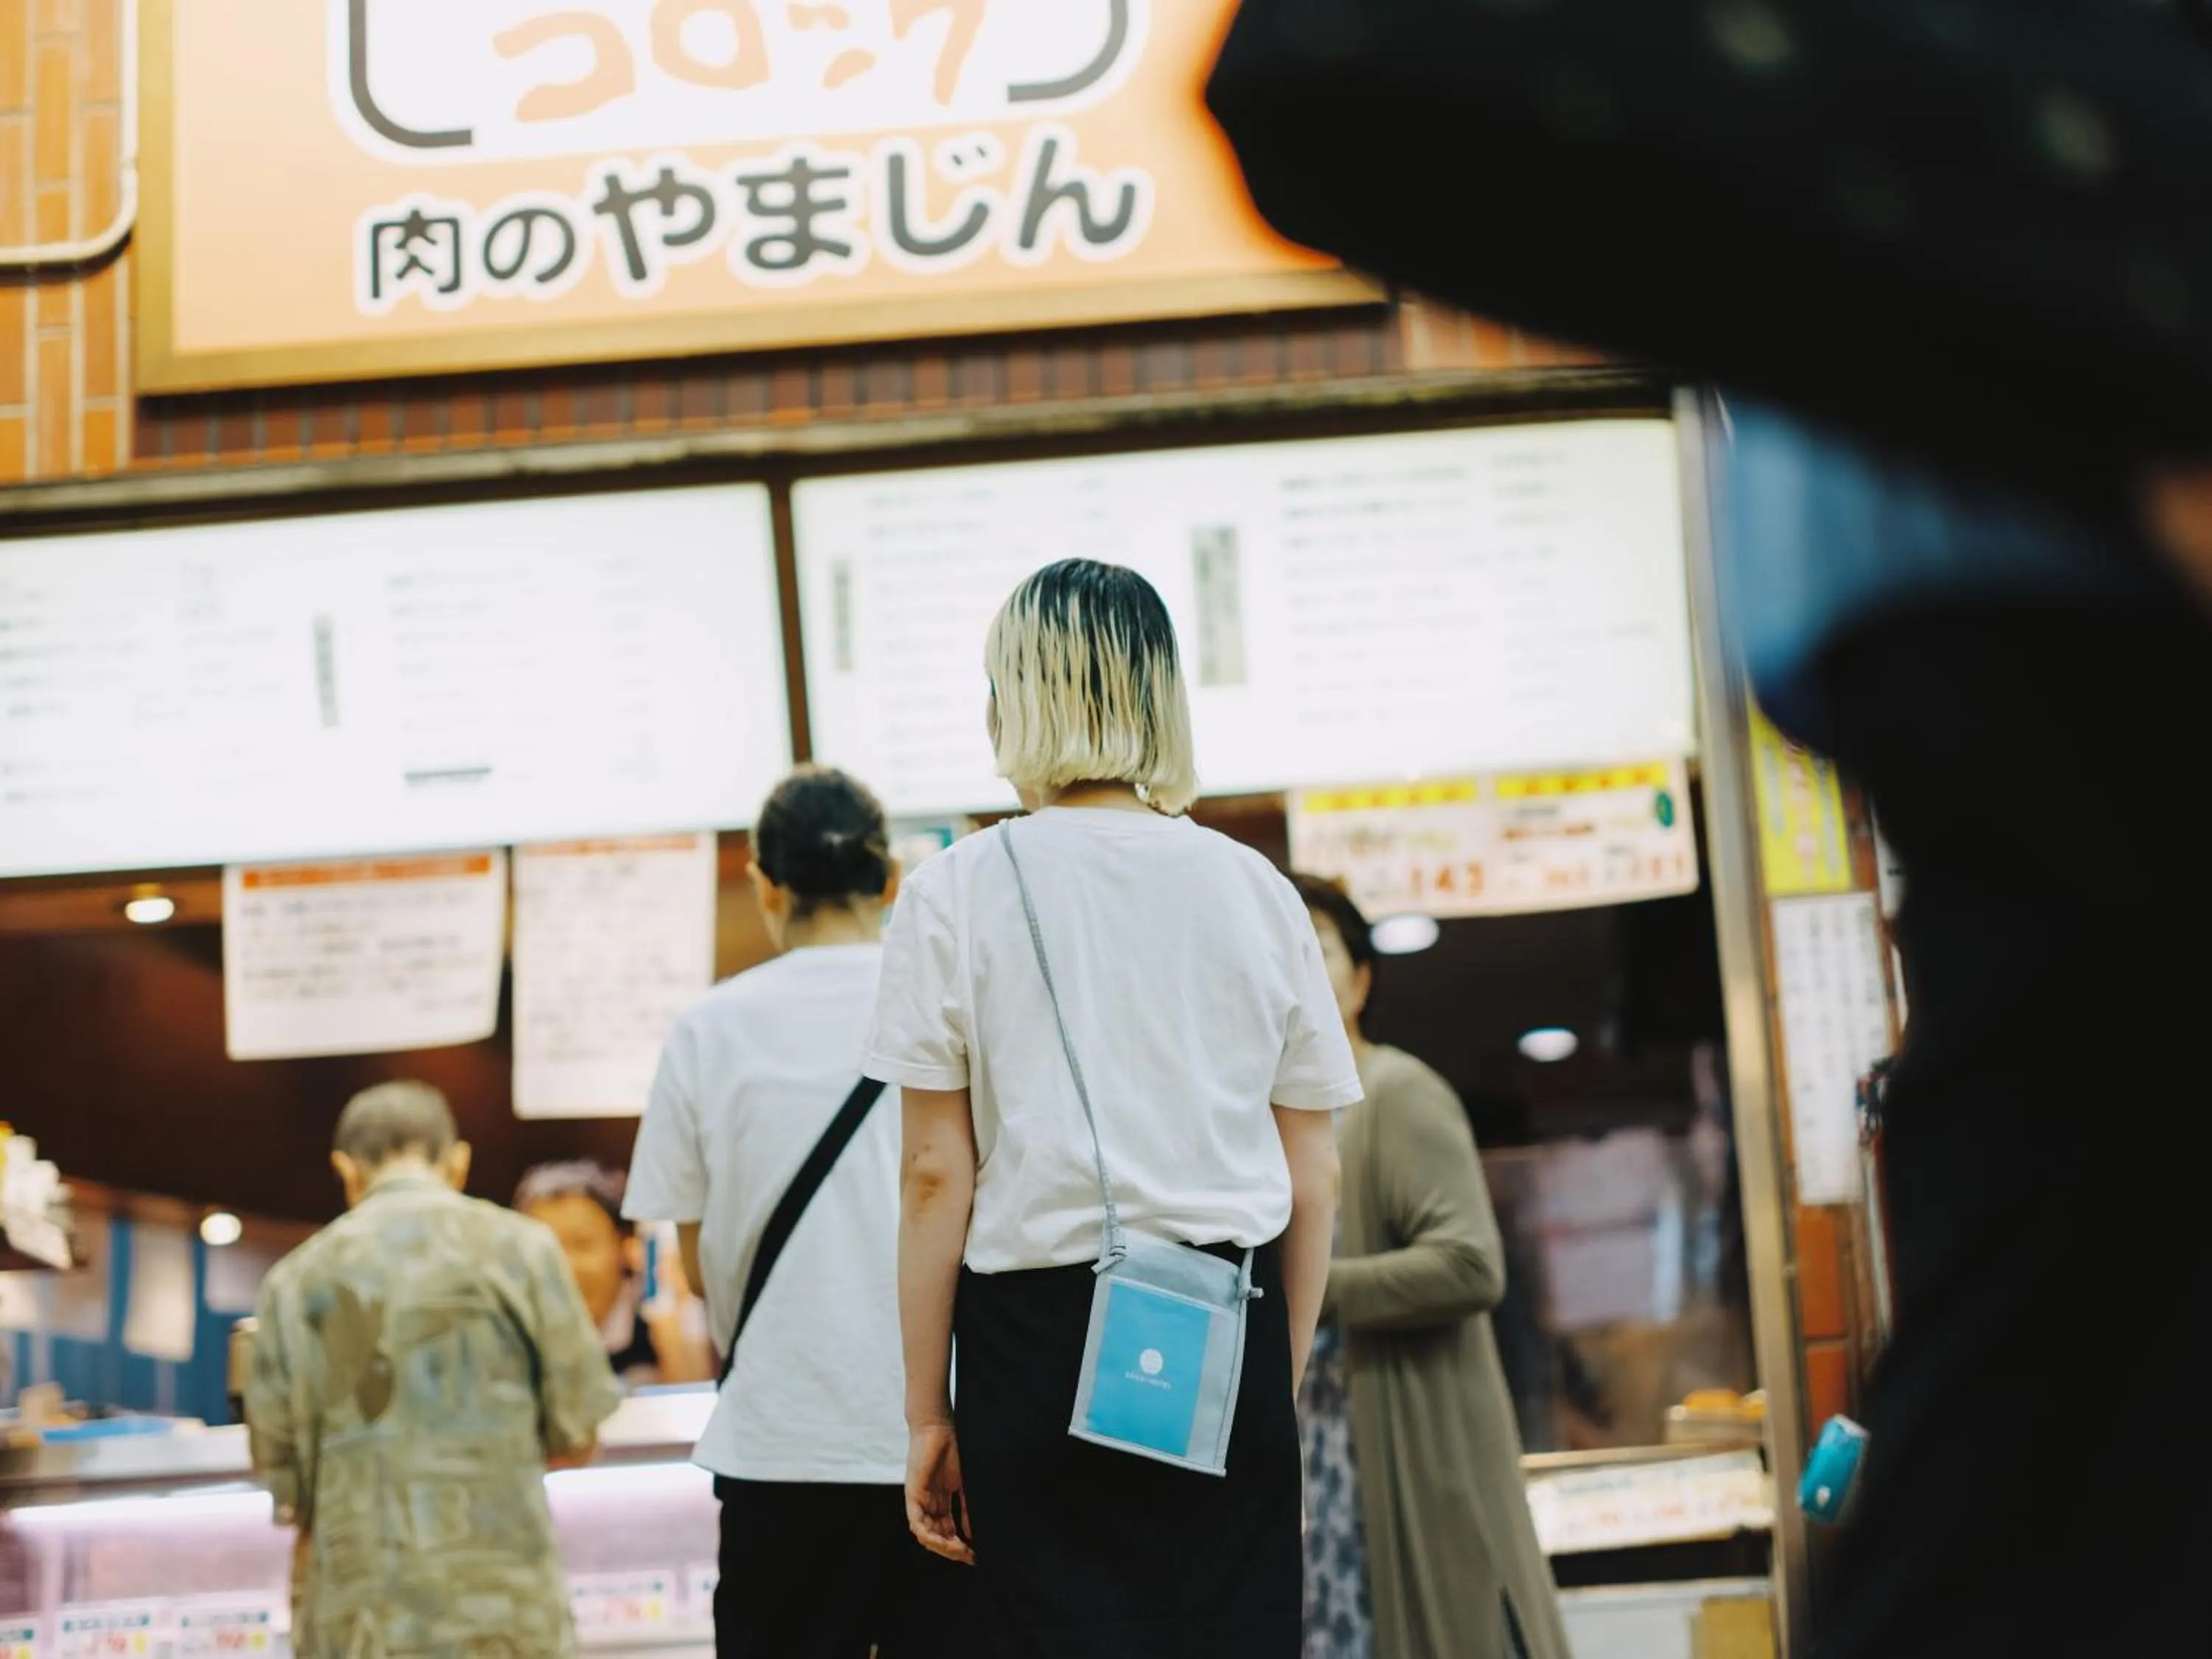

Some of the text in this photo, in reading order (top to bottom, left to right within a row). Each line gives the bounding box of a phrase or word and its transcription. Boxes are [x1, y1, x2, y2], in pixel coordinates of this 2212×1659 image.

[371, 137, 1136, 299] 肉のやまじん
